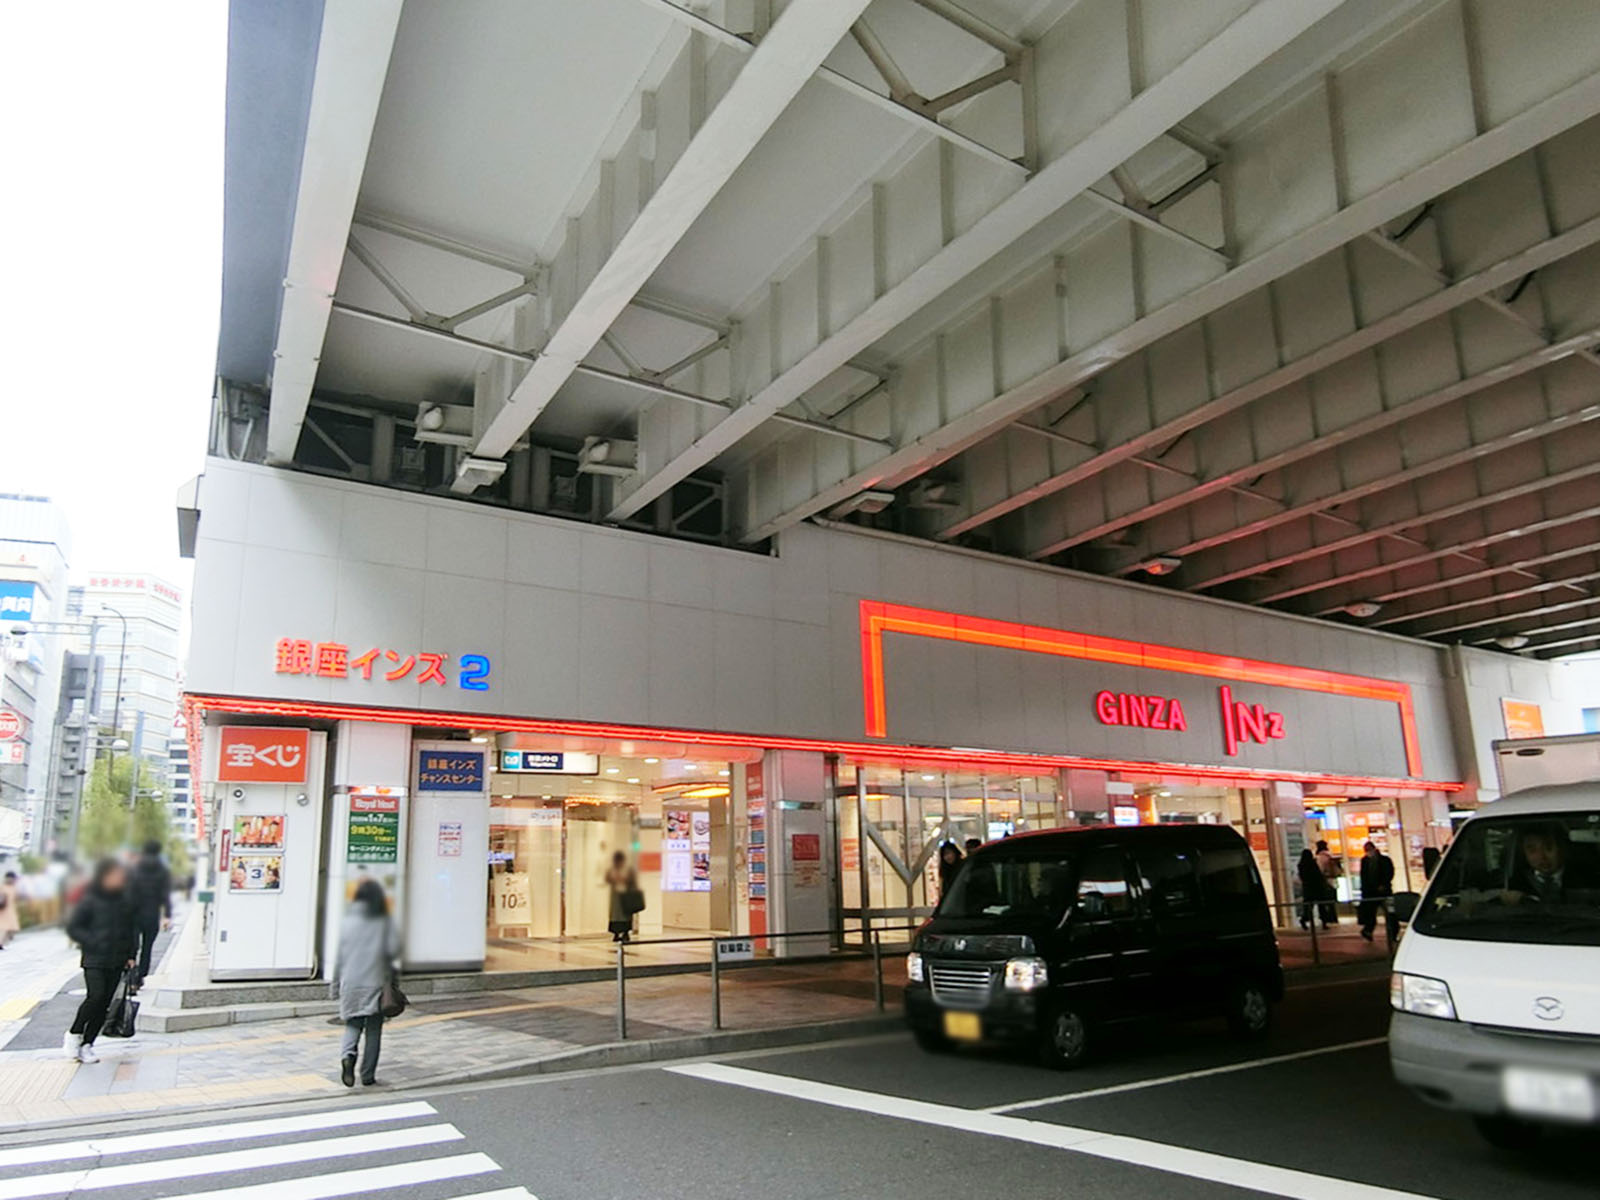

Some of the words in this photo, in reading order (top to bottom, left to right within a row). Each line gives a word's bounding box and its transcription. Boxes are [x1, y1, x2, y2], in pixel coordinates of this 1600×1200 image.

[275, 637, 448, 686] 銀座インズ
[459, 654, 491, 691] 2
[1096, 690, 1187, 732] GINZA
[226, 744, 301, 768] 宝くじ
[420, 772, 483, 784] チャンスセンター
